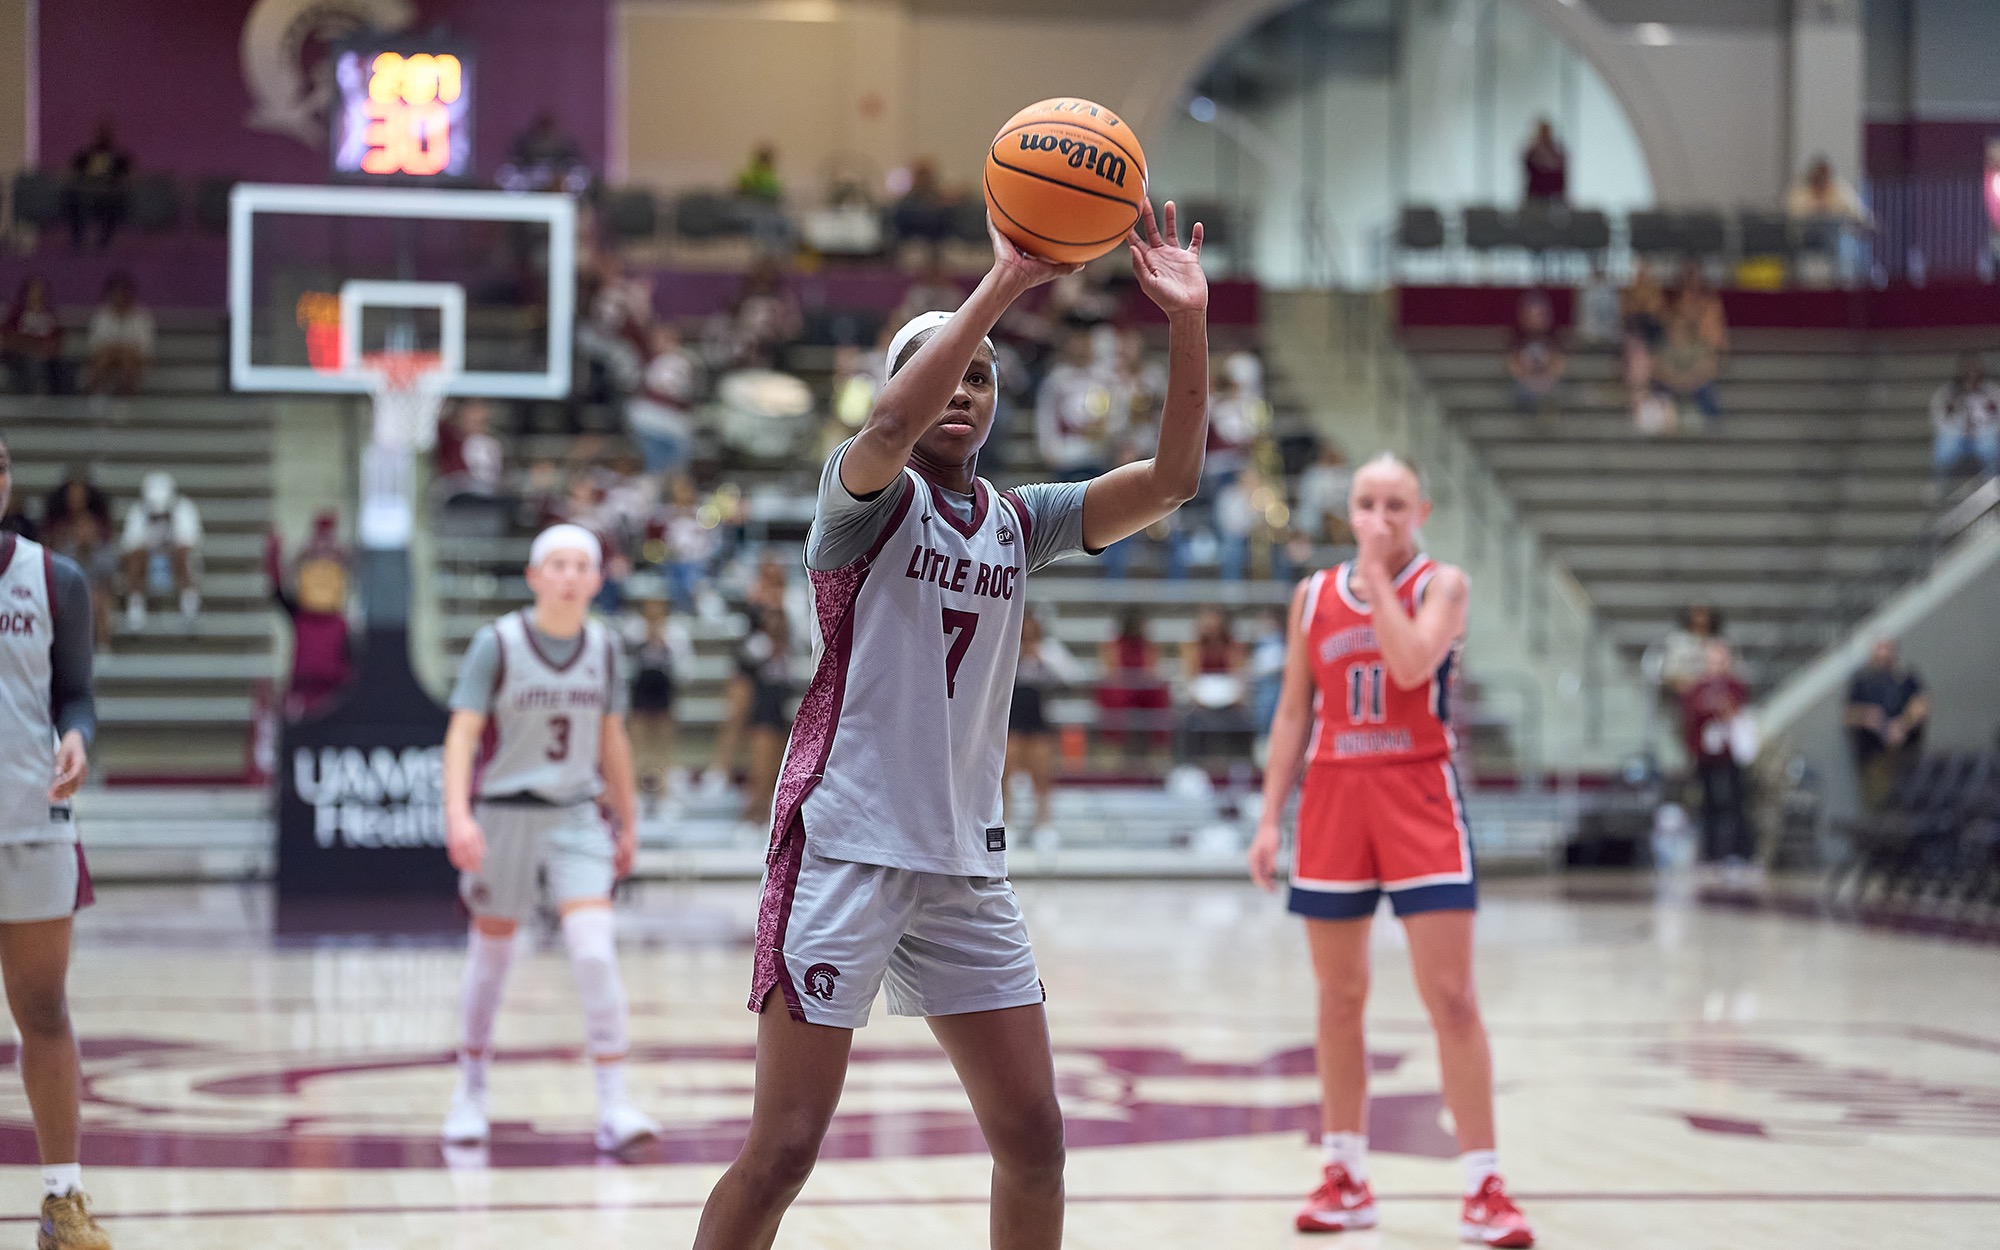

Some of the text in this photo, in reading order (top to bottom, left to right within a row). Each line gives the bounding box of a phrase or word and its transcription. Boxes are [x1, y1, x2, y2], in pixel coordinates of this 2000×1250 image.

[360, 98, 450, 176] 30
[1020, 133, 1127, 189] Wilson
[905, 544, 972, 593] LITLE
[0, 612, 35, 638] OCK
[942, 607, 979, 699] 7
[1346, 661, 1387, 725] 11
[546, 714, 571, 762] 3
